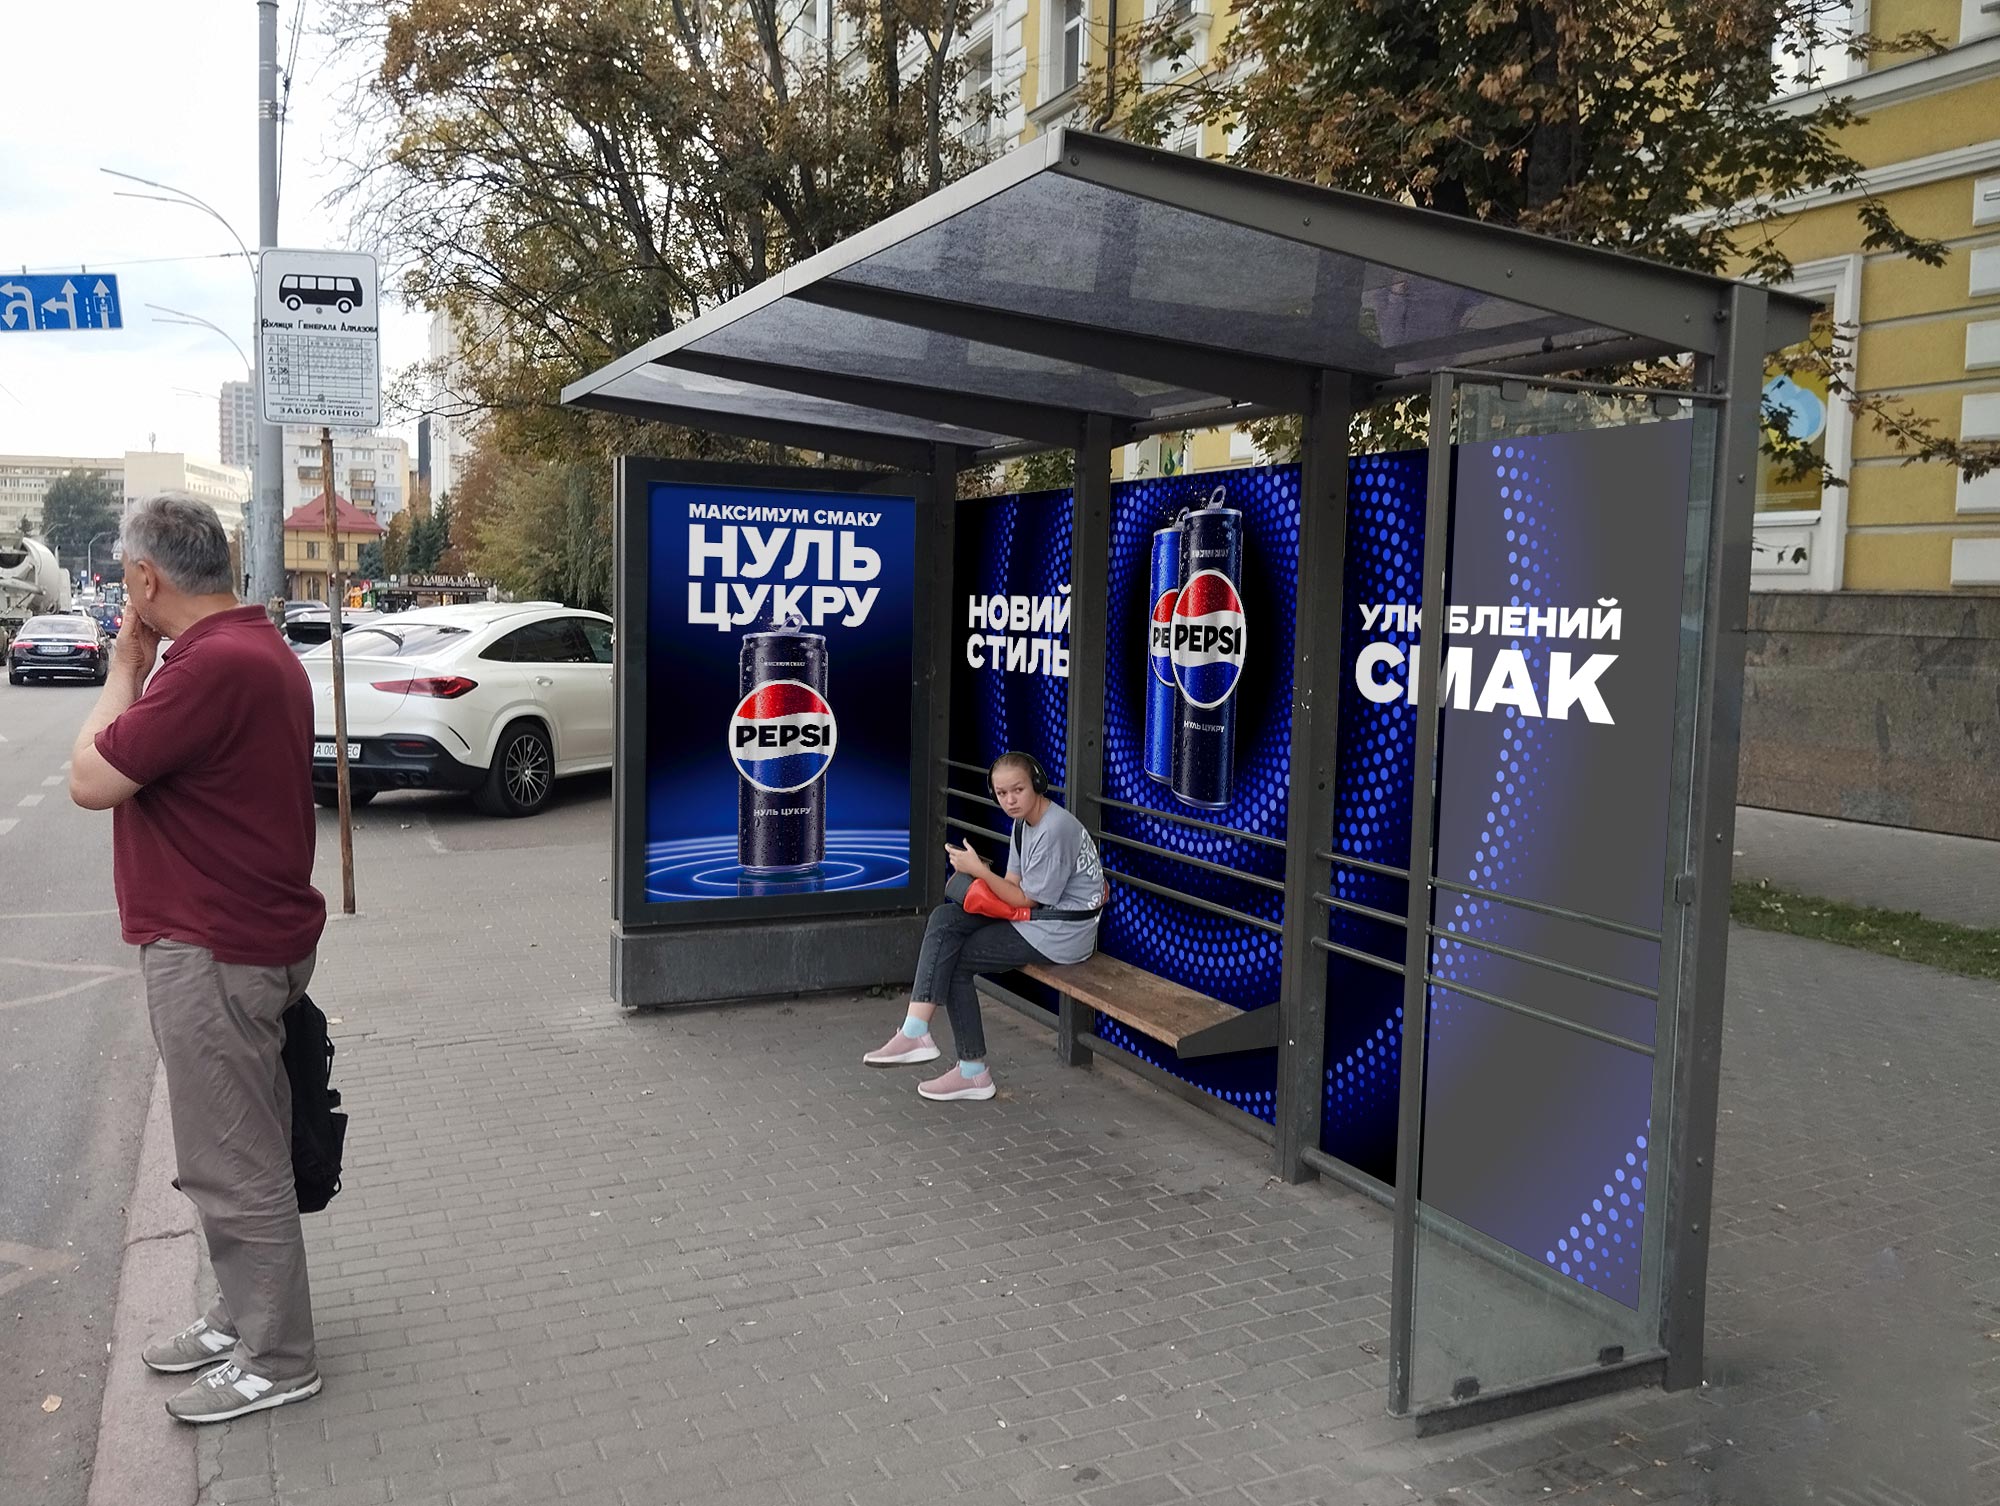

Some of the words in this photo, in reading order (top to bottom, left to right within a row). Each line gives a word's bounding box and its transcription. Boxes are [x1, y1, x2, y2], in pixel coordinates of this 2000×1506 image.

[280, 407, 364, 418] ЗАБОРОНЕНО!
[689, 503, 809, 524] МАКСИМУМ
[814, 509, 882, 527] СМАКУ
[688, 523, 882, 582] НУЛЬ
[688, 582, 881, 632] ЦУКРУ
[969, 583, 1072, 634] НОВИЙ
[966, 633, 1070, 678] СТИЛЬ
[1174, 624, 1242, 656] PEPSI
[1355, 641, 1619, 725] СМАК
[735, 724, 831, 748] PEPSI
[754, 808, 779, 817] НУЛЬ
[781, 807, 812, 816] ЦУКРУ
